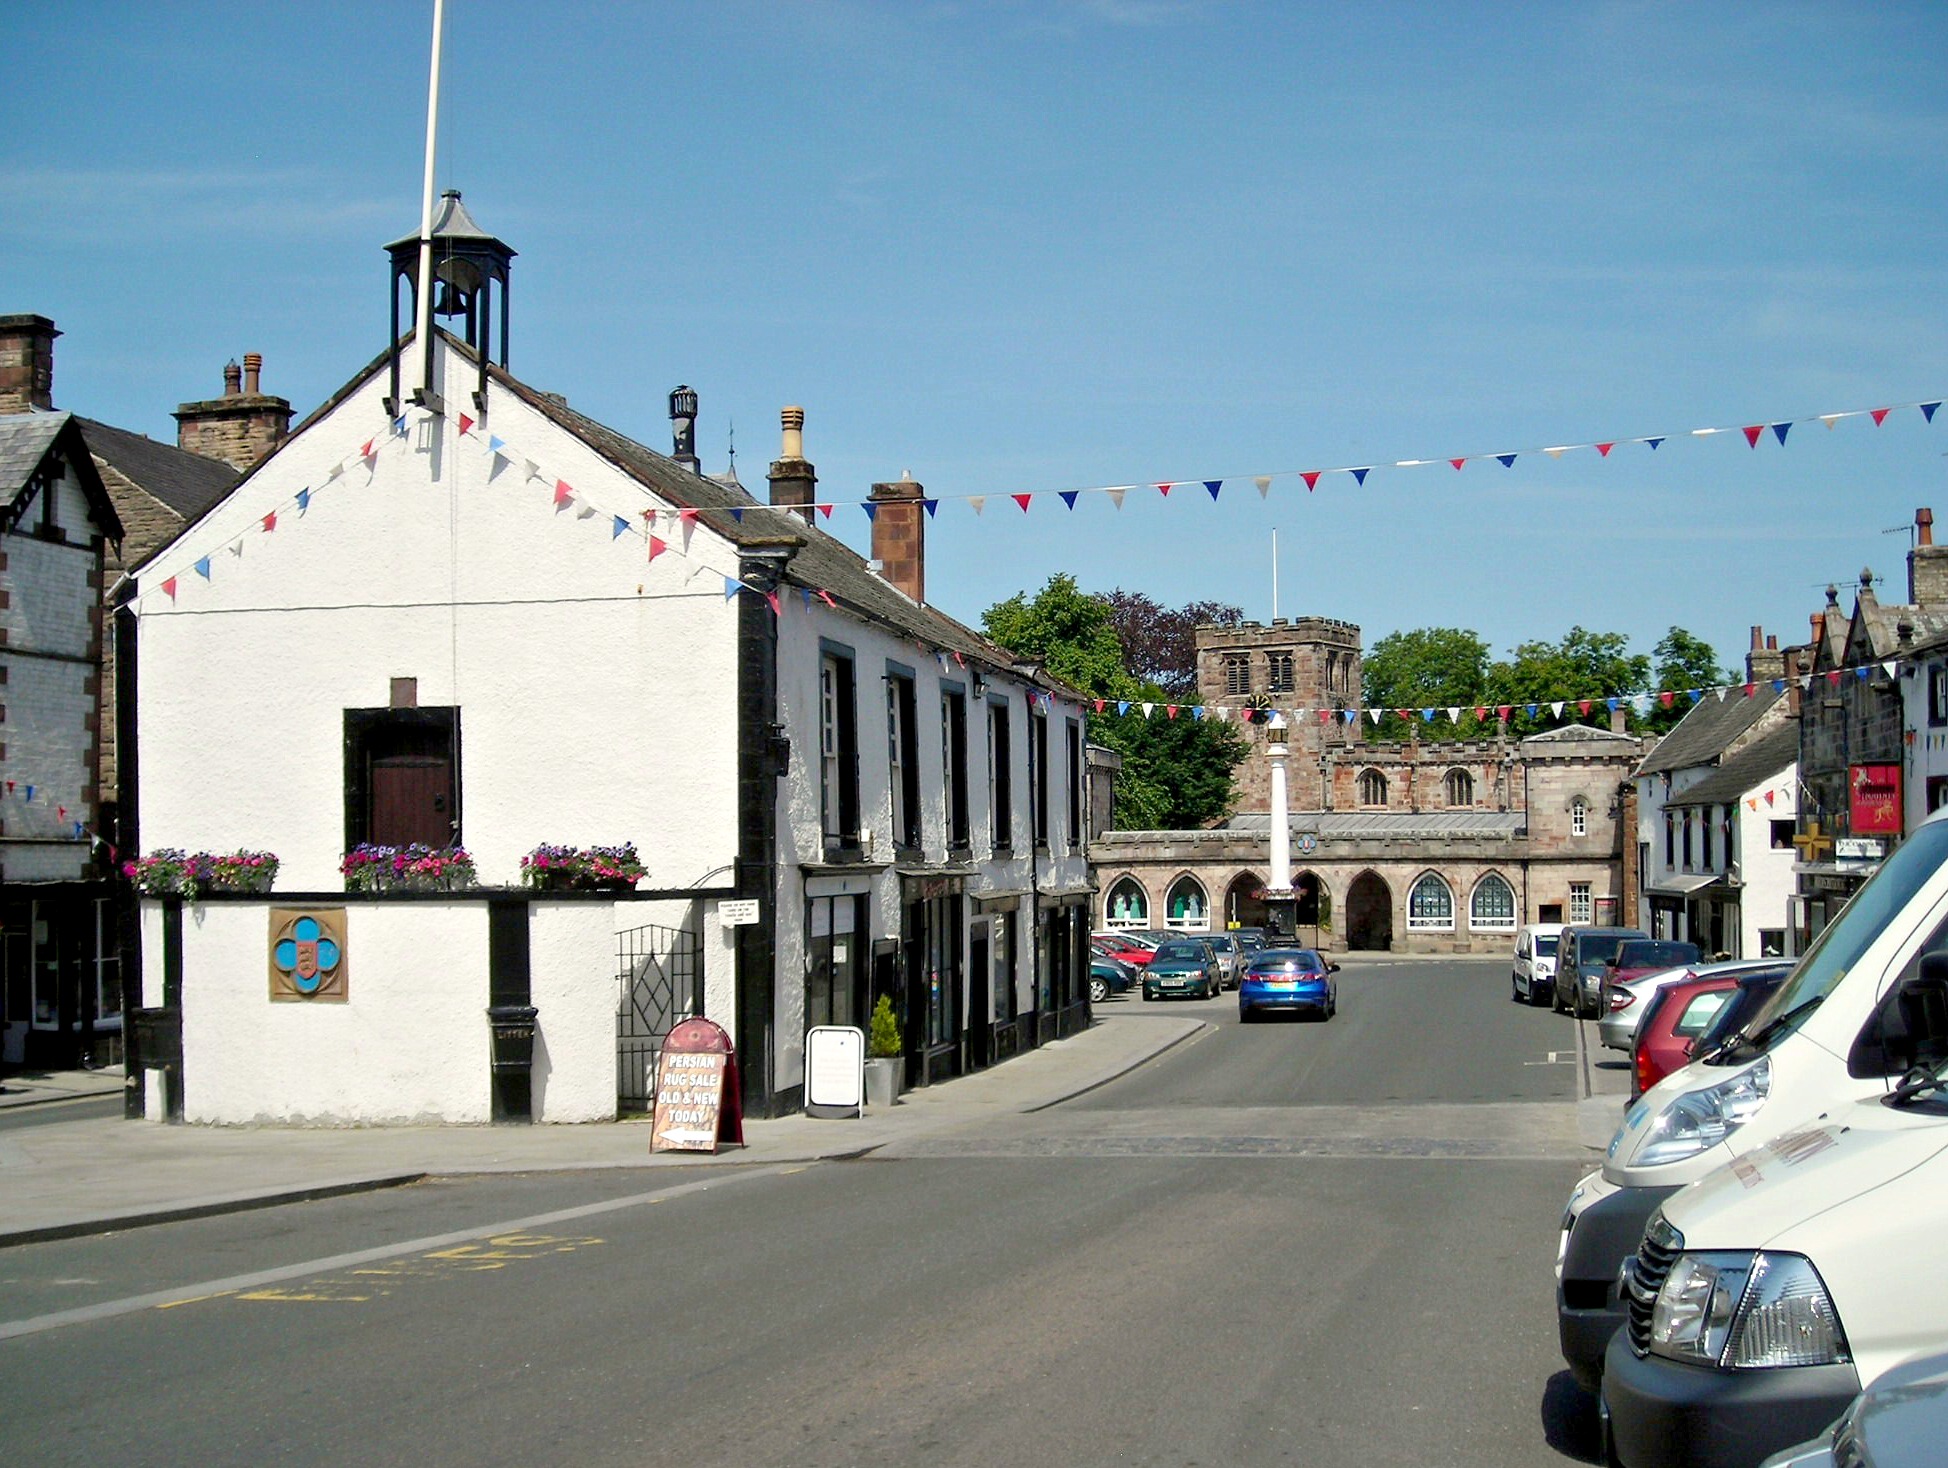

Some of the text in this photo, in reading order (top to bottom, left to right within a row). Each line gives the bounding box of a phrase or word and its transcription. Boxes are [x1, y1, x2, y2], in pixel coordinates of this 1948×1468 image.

[669, 1055, 715, 1068] PERSIAN
[664, 1073, 717, 1087] RUG SALE
[658, 1092, 718, 1105] OLD & NEW
[669, 1110, 704, 1123] TODAY
